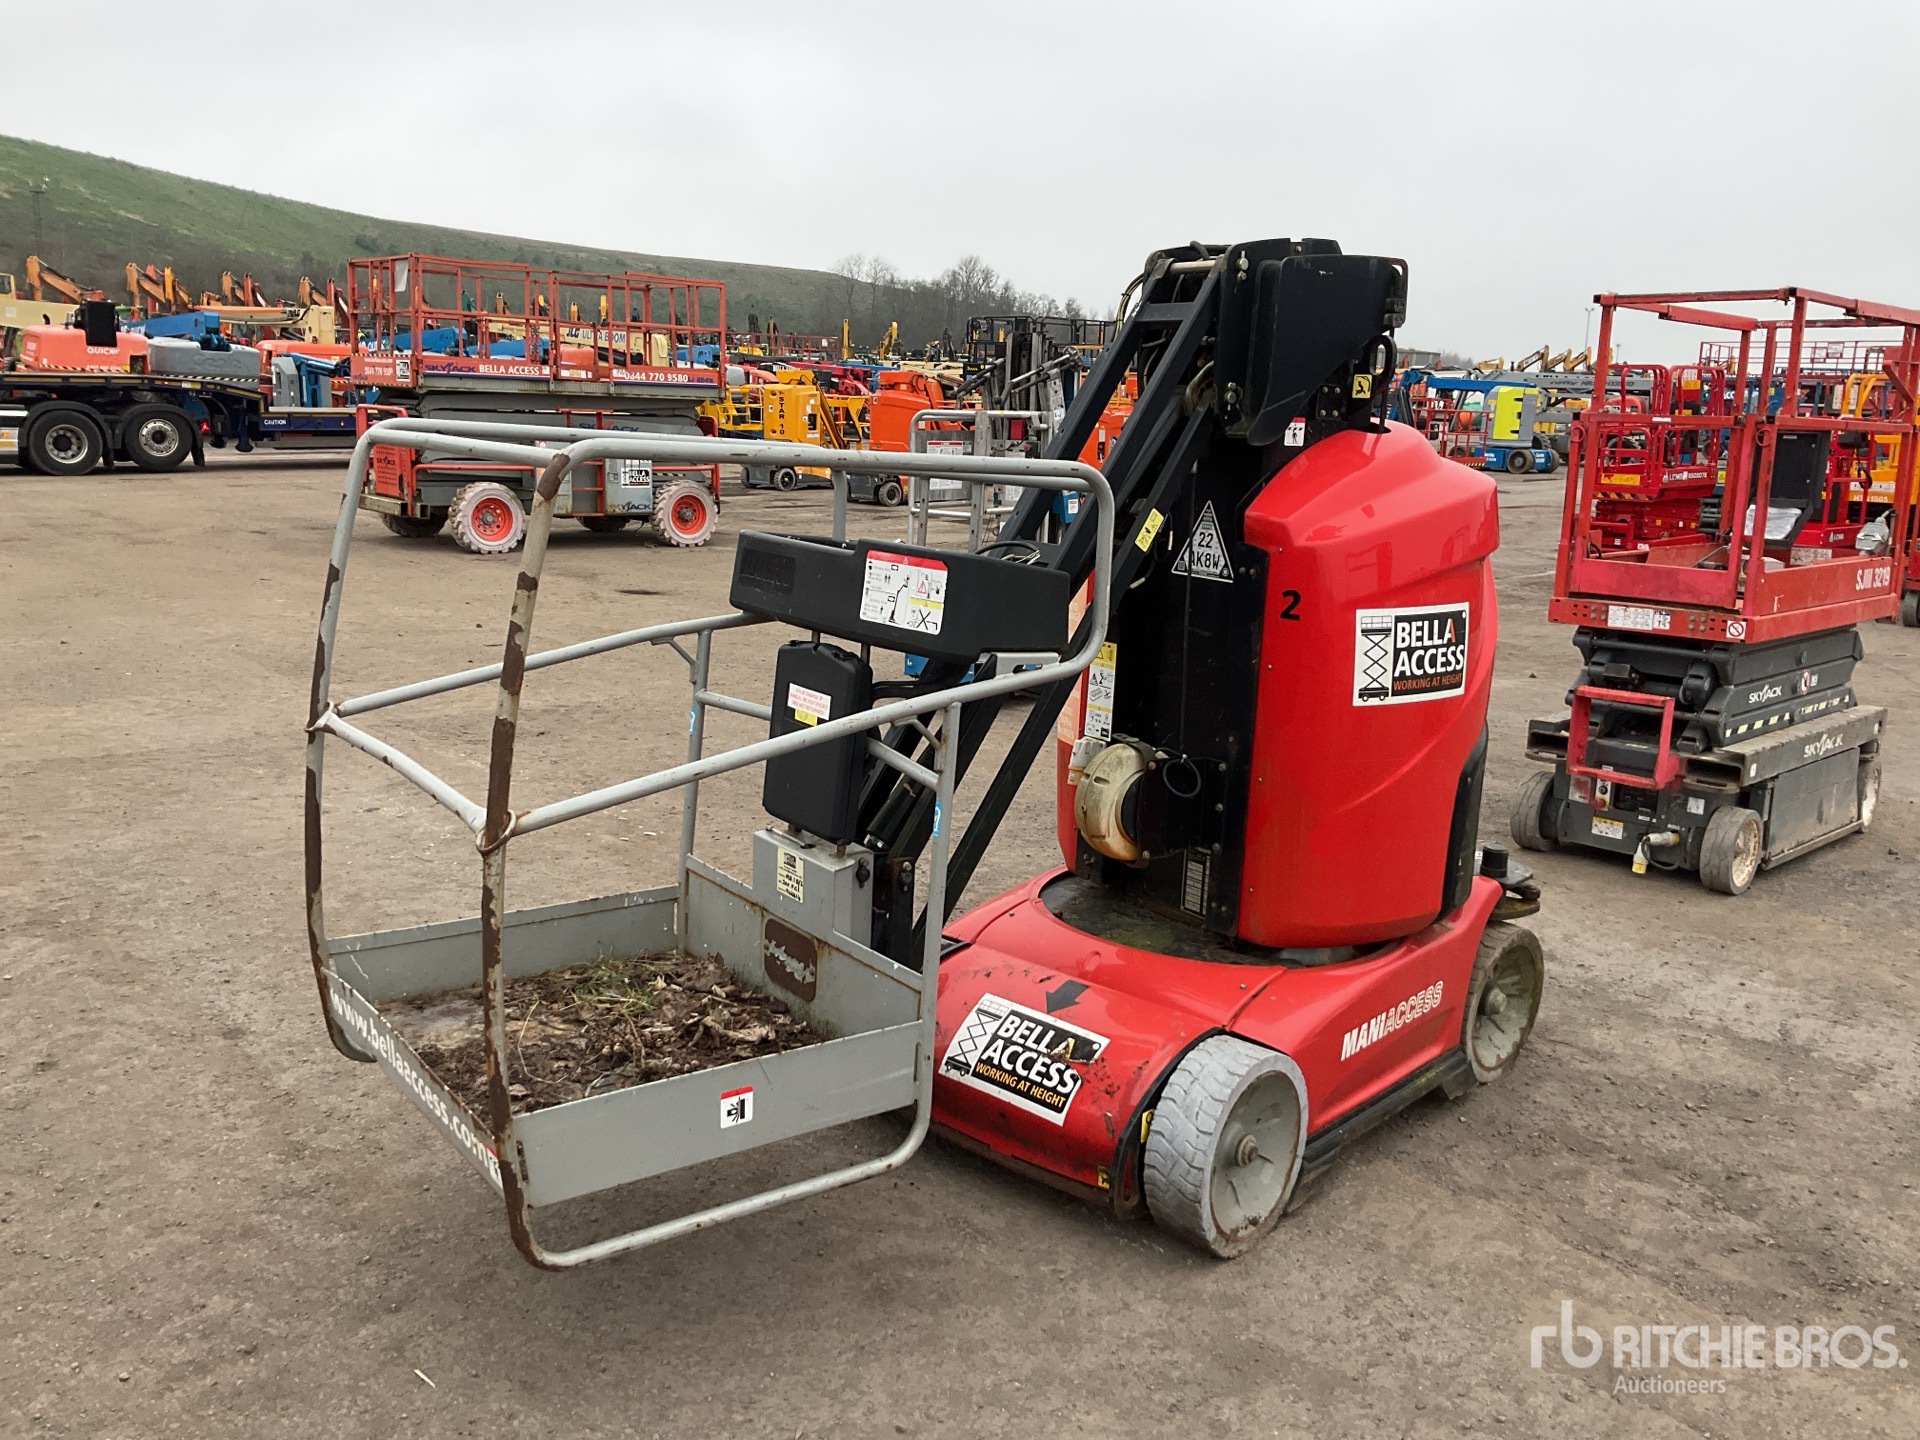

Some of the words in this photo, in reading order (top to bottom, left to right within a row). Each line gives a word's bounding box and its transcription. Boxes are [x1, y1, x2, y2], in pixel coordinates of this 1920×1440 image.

[566, 327, 580, 338] JLG
[582, 329, 603, 341] ULTA
[605, 331, 625, 343] BOM
[424, 362, 476, 374] SKYJACK
[479, 364, 505, 374] BELLA
[508, 365, 540, 375] ACCESS
[648, 373, 664, 382] 770
[667, 374, 689, 383] 9580
[778, 396, 786, 420] STAR
[779, 424, 785, 434] 10
[1197, 532, 1214, 549] 22
[1873, 566, 1891, 588] 3219
[1279, 590, 1303, 621] 2
[1396, 618, 1456, 649] BELLA
[1393, 644, 1465, 677] ACCESS
[1393, 677, 1431, 691] WORKING
[1431, 676, 1441, 687] AT
[1441, 673, 1463, 686] HEIGHT
[1748, 684, 1782, 704] SKYJACK
[1803, 733, 1844, 758] SKYJACK
[1340, 980, 1444, 1062] MANIACCESS
[996, 1014, 1076, 1062] BELLA
[981, 1038, 1077, 1094] ACCESS
[975, 1062, 1018, 1088] WORKING
[1017, 1079, 1031, 1092] AT
[1030, 1084, 1066, 1108] HEIGHT
